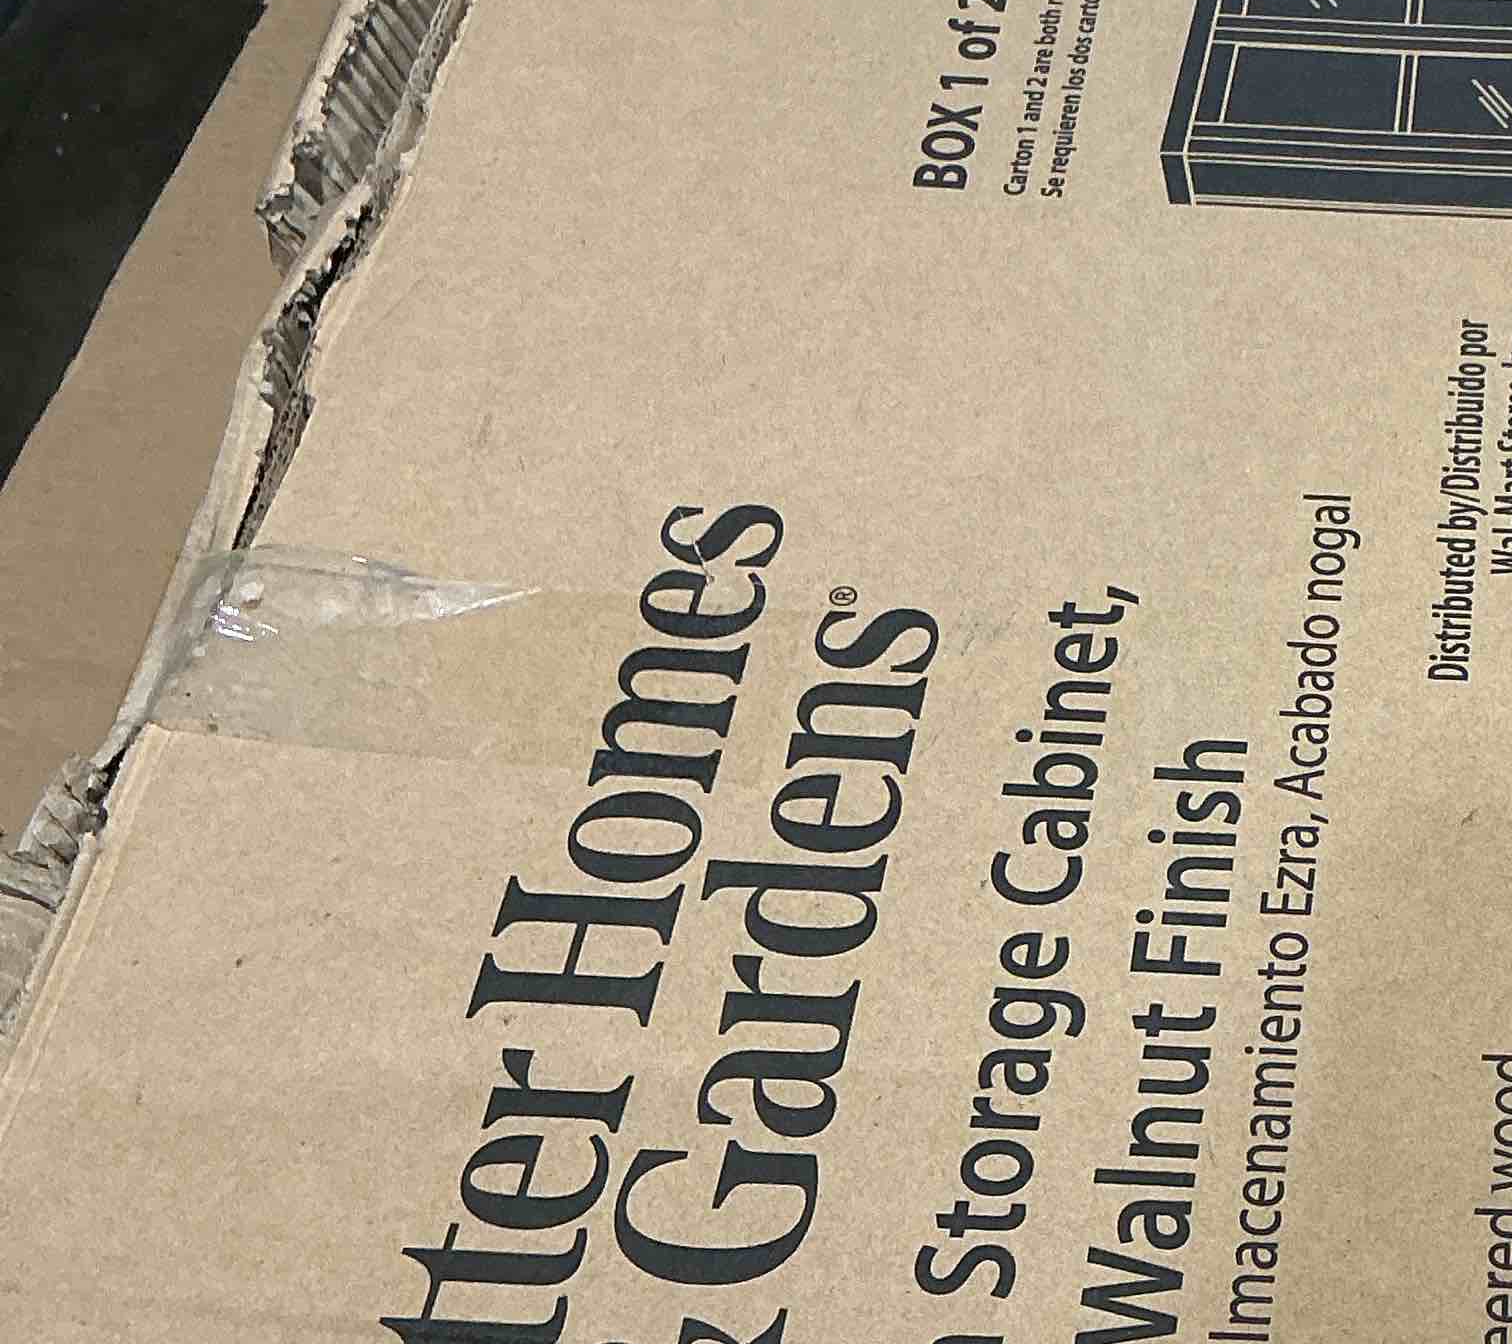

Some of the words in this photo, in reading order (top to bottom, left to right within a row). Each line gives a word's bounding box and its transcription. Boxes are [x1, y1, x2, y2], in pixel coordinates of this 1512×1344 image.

[948, 19, 1000, 60] of
[1034, 10, 1061, 45] both
[1067, 36, 1092, 64] dos
[940, 75, 988, 89] 1
[1027, 78, 1047, 87] 2
[1034, 49, 1053, 74] are
[1061, 68, 1086, 90] los
[1023, 91, 1044, 121] and
[1051, 95, 1081, 173] requieren
[913, 103, 983, 189] BOX
[1003, 139, 1035, 195] Carton
[1041, 178, 1065, 198] Se
[1461, 319, 1496, 357] por
[1437, 363, 1488, 530] by/Distribuido
[1303, 495, 1360, 601] nogal
[1428, 537, 1476, 681] Distributed
[1274, 615, 1339, 800] Acabado
[465, 505, 783, 1027] Homes
[991, 586, 1139, 905] Cabinet,
[1130, 740, 1248, 976] Finish
[1260, 814, 1328, 915] Ezra,
[915, 933, 1085, 1299] Storage
